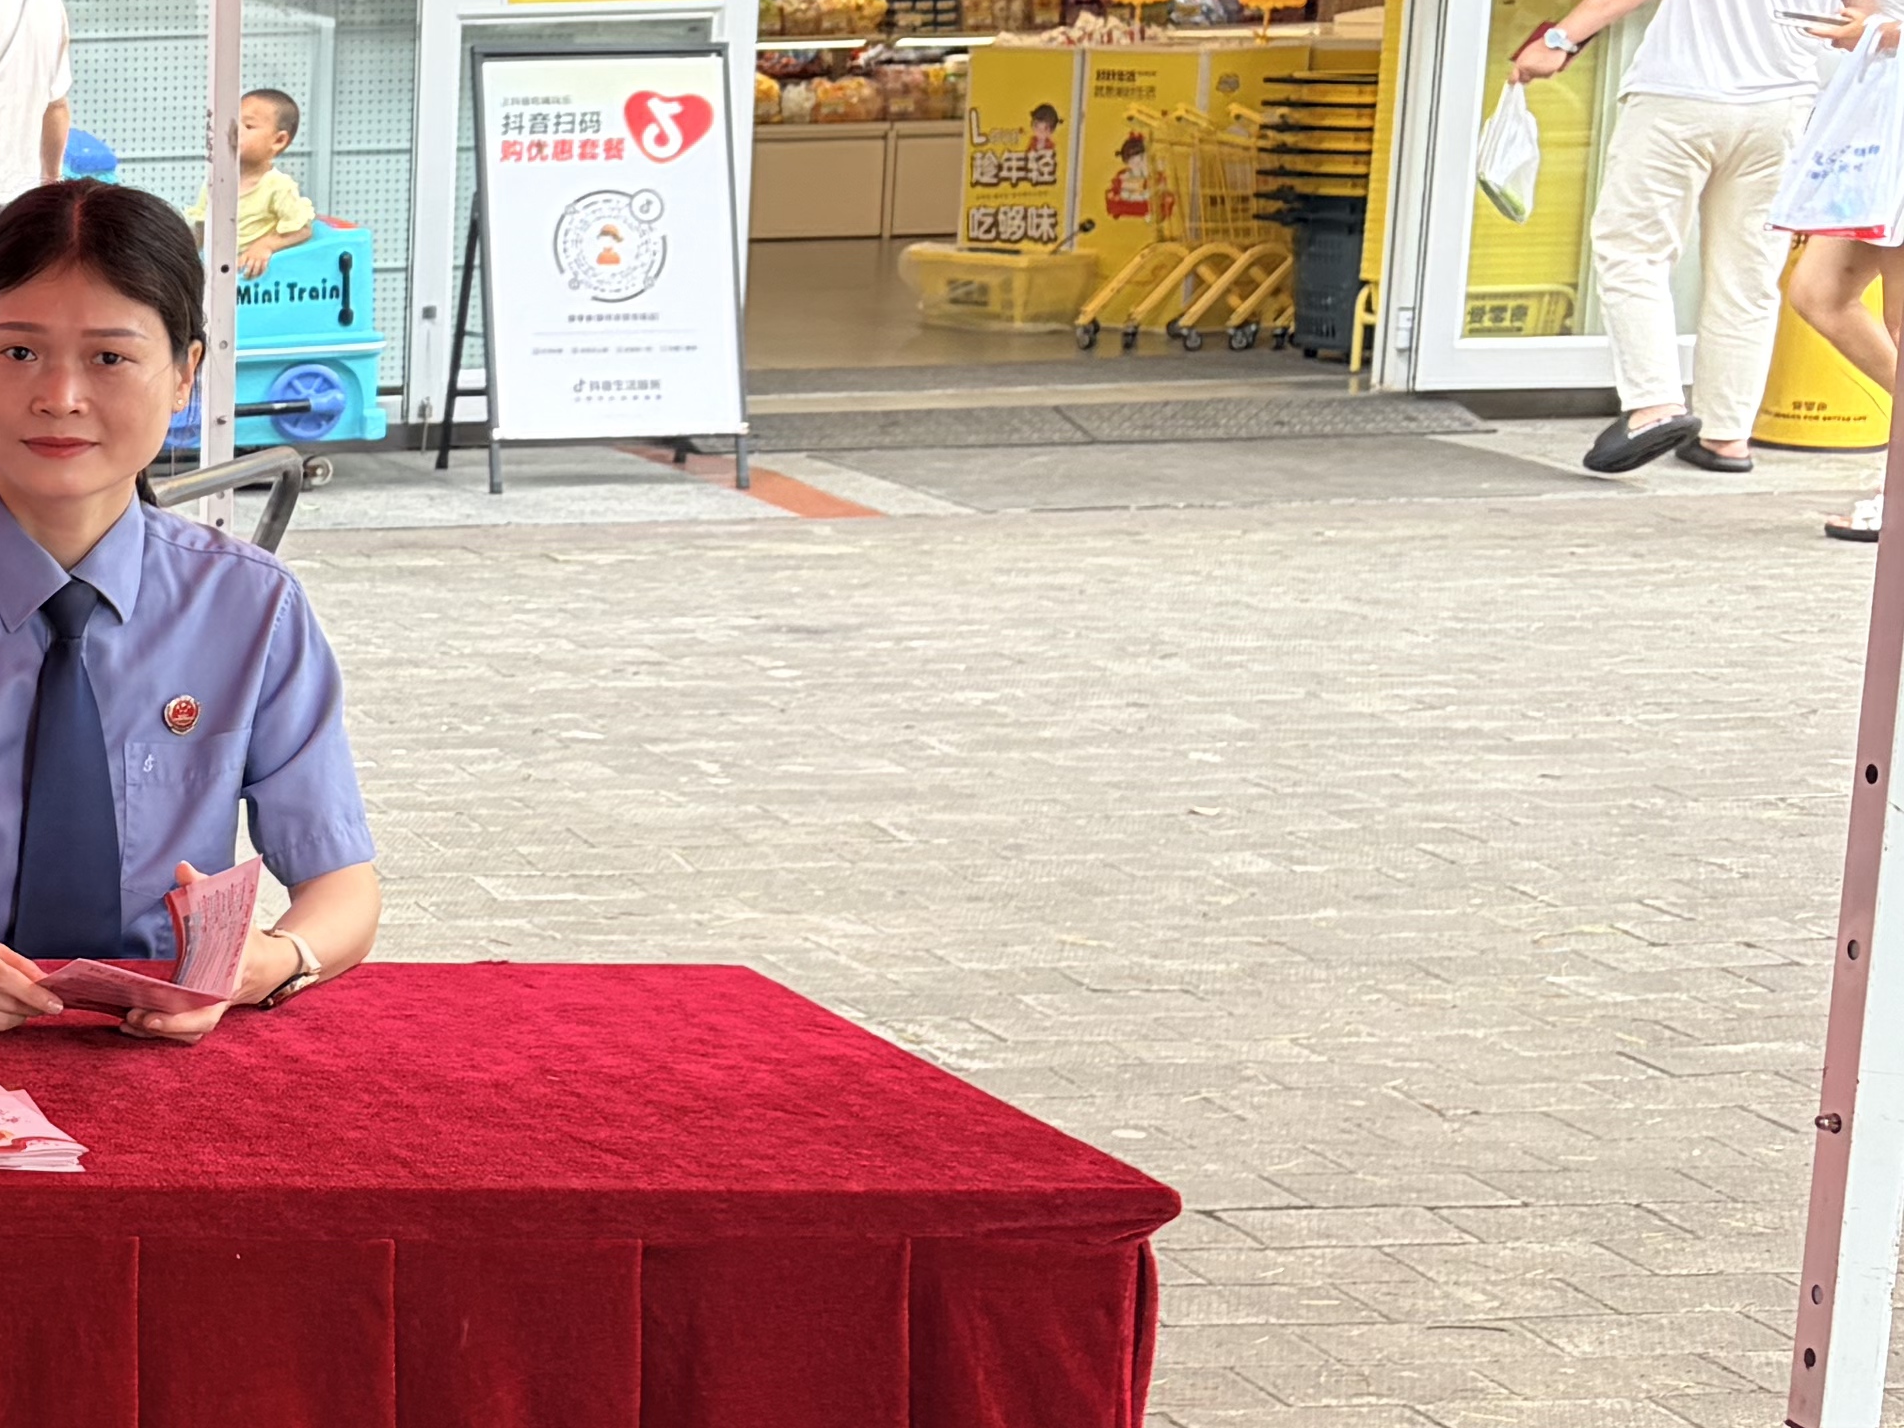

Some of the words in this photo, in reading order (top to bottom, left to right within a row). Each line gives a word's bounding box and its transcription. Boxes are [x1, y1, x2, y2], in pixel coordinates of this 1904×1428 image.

[501, 111, 602, 135] 抖音扫码
[500, 137, 626, 163] 购优惠套餐
[970, 149, 1057, 188] 趁年轻
[968, 204, 1058, 243] 吃够味
[236, 280, 280, 306] Mini
[286, 278, 340, 303] Train
